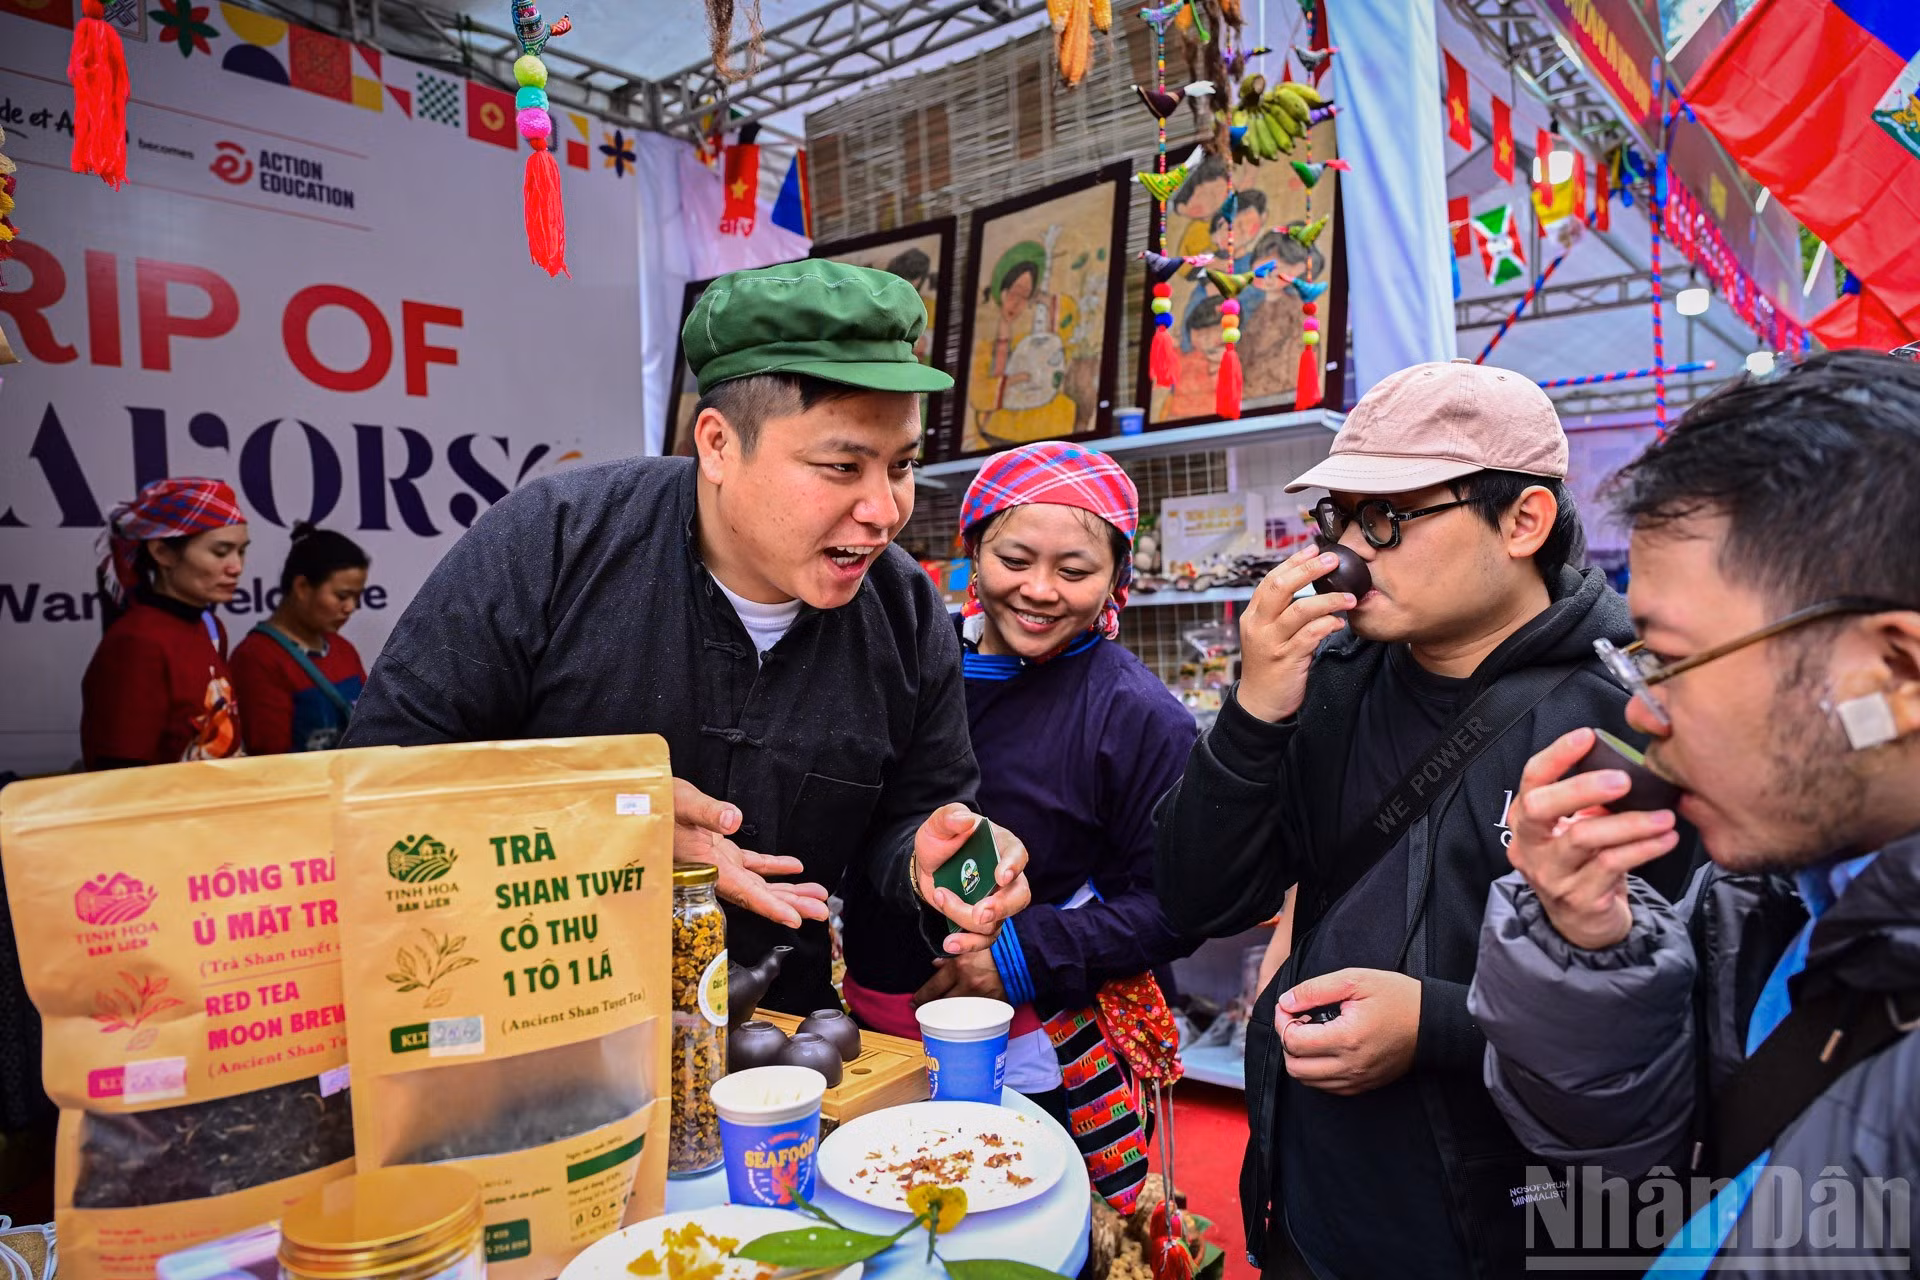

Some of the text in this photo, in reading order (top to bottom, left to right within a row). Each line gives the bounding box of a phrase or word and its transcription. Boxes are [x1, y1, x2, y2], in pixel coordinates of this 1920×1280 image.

[29, 108, 54, 129] et
[138, 138, 195, 160] becomes
[259, 150, 323, 181] ACTION
[260, 171, 355, 209] EDUCATION
[281, 284, 464, 397] OF
[1374, 715, 1493, 836] WE POWER
[489, 826, 557, 867] TRÀ
[187, 862, 283, 903] HỒNG
[386, 882, 459, 901] TINH HOA
[495, 858, 645, 910] SHAN TUYẾT
[76, 921, 160, 945] TINH HOA
[193, 912, 217, 945] Ủ
[500, 912, 598, 953] CỔ THỤ
[244, 952, 285, 968] Shan
[503, 948, 613, 997] 1 TÔ 1 LÁ
[206, 980, 300, 1017] RED TEA
[208, 1017, 283, 1051] MOON
[501, 1011, 565, 1035] (Ancient
[568, 1003, 600, 1021] Shan
[287, 1042, 325, 1059] Shan
[1511, 1190, 1566, 1208] MINIMALIST
